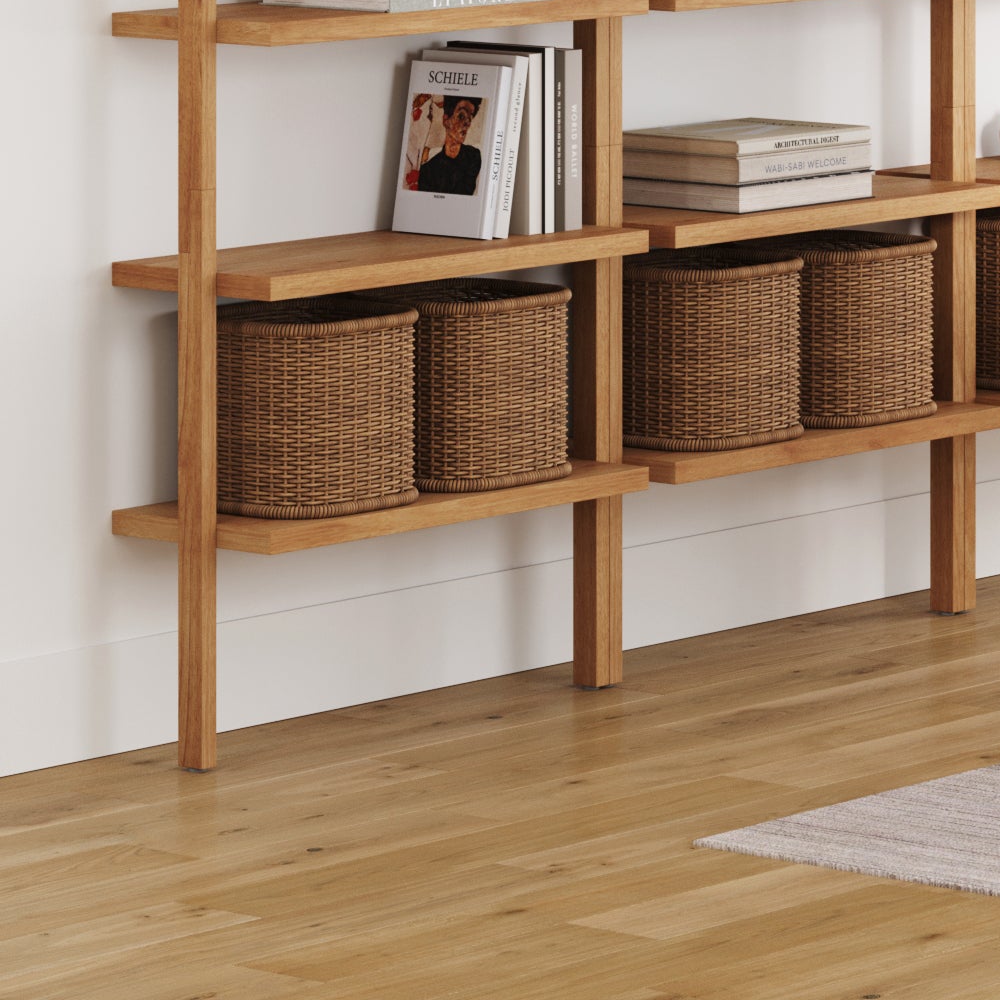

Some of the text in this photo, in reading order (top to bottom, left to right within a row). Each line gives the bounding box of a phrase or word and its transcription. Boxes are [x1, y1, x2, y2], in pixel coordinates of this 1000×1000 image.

[428, 70, 479, 87] SCHIELE
[773, 135, 840, 149] ARCHITECTURAL DIGEST
[492, 130, 504, 181] SCHIELE
[765, 156, 847, 174] WABI-SABI WELCOME
[502, 190, 510, 212] JODI
